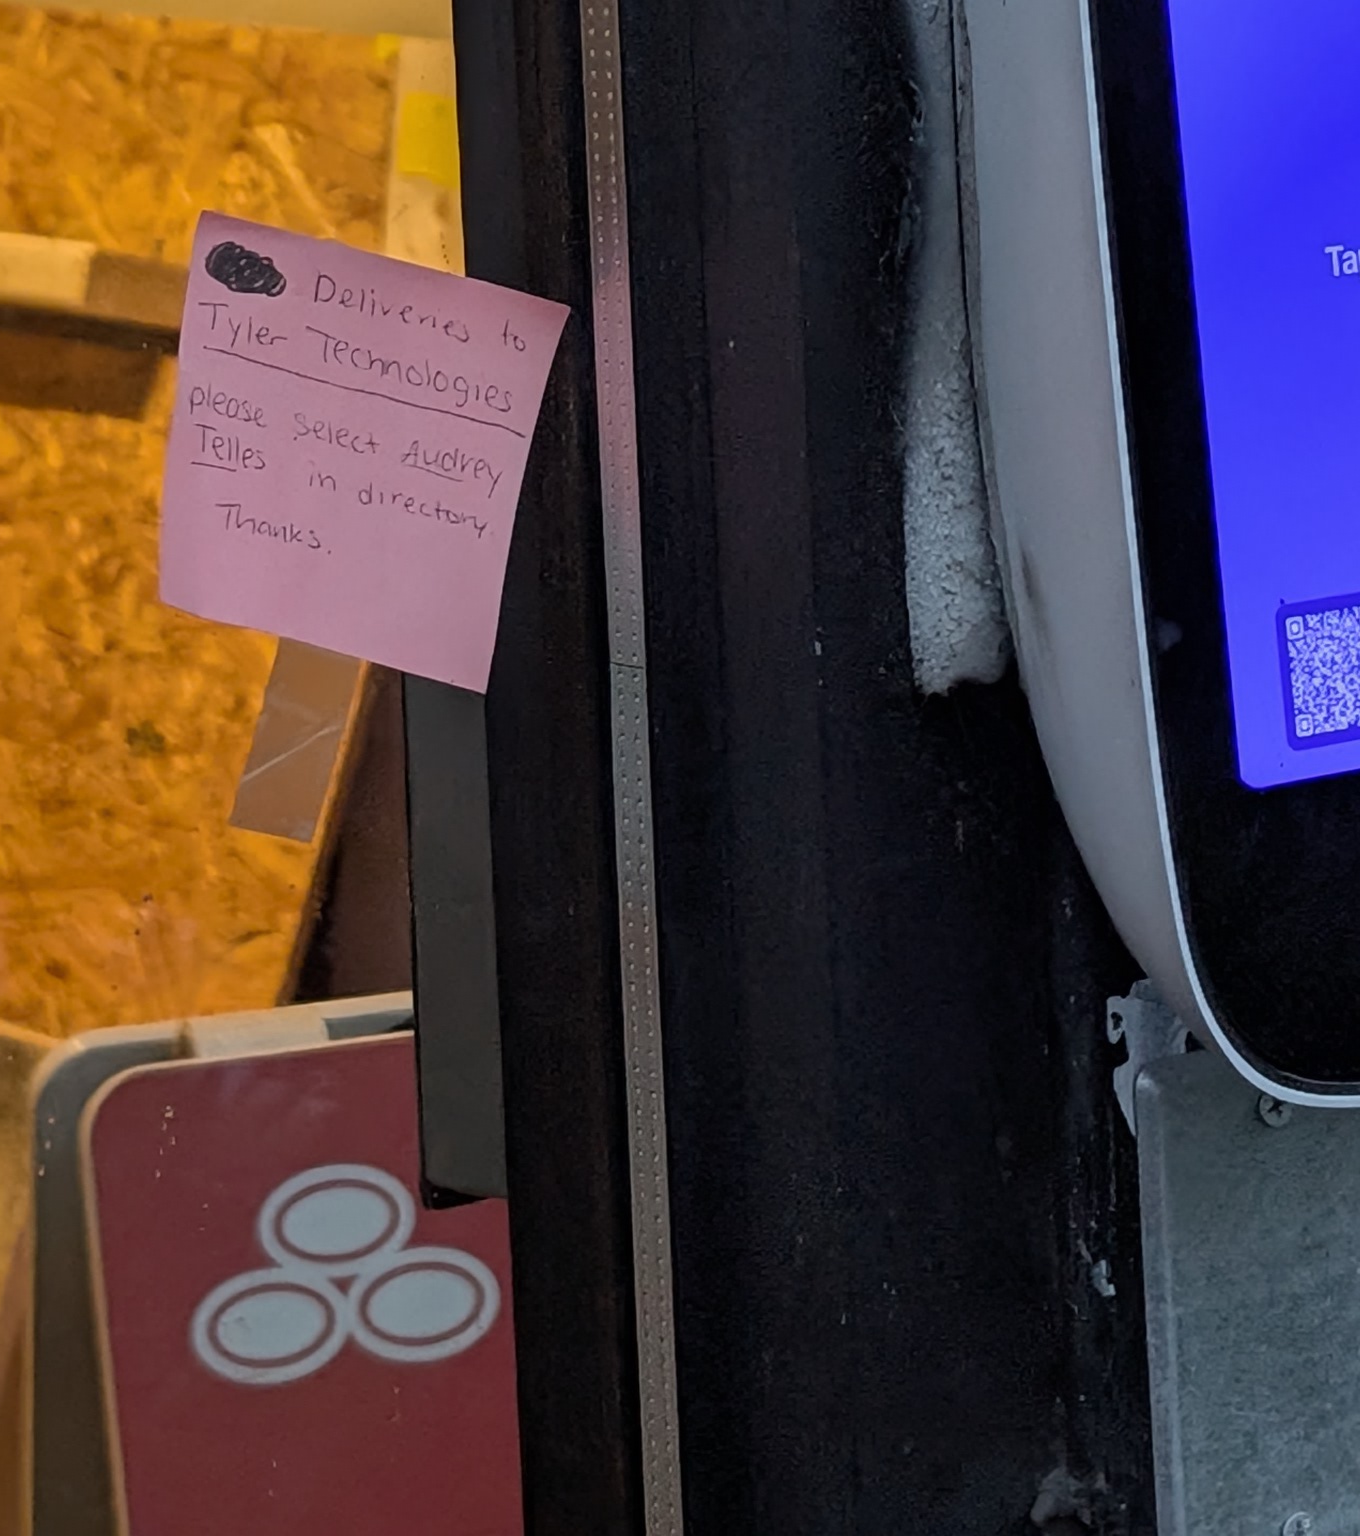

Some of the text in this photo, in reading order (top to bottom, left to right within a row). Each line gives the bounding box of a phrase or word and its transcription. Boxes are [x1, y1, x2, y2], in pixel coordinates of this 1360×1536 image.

[198, 301, 512, 414] Tyler Technologies
[314, 274, 527, 352] Deliveries to
[189, 384, 268, 429] please
[401, 439, 504, 498] Audrey
[194, 423, 267, 470] Telles
[309, 460, 337, 492] in
